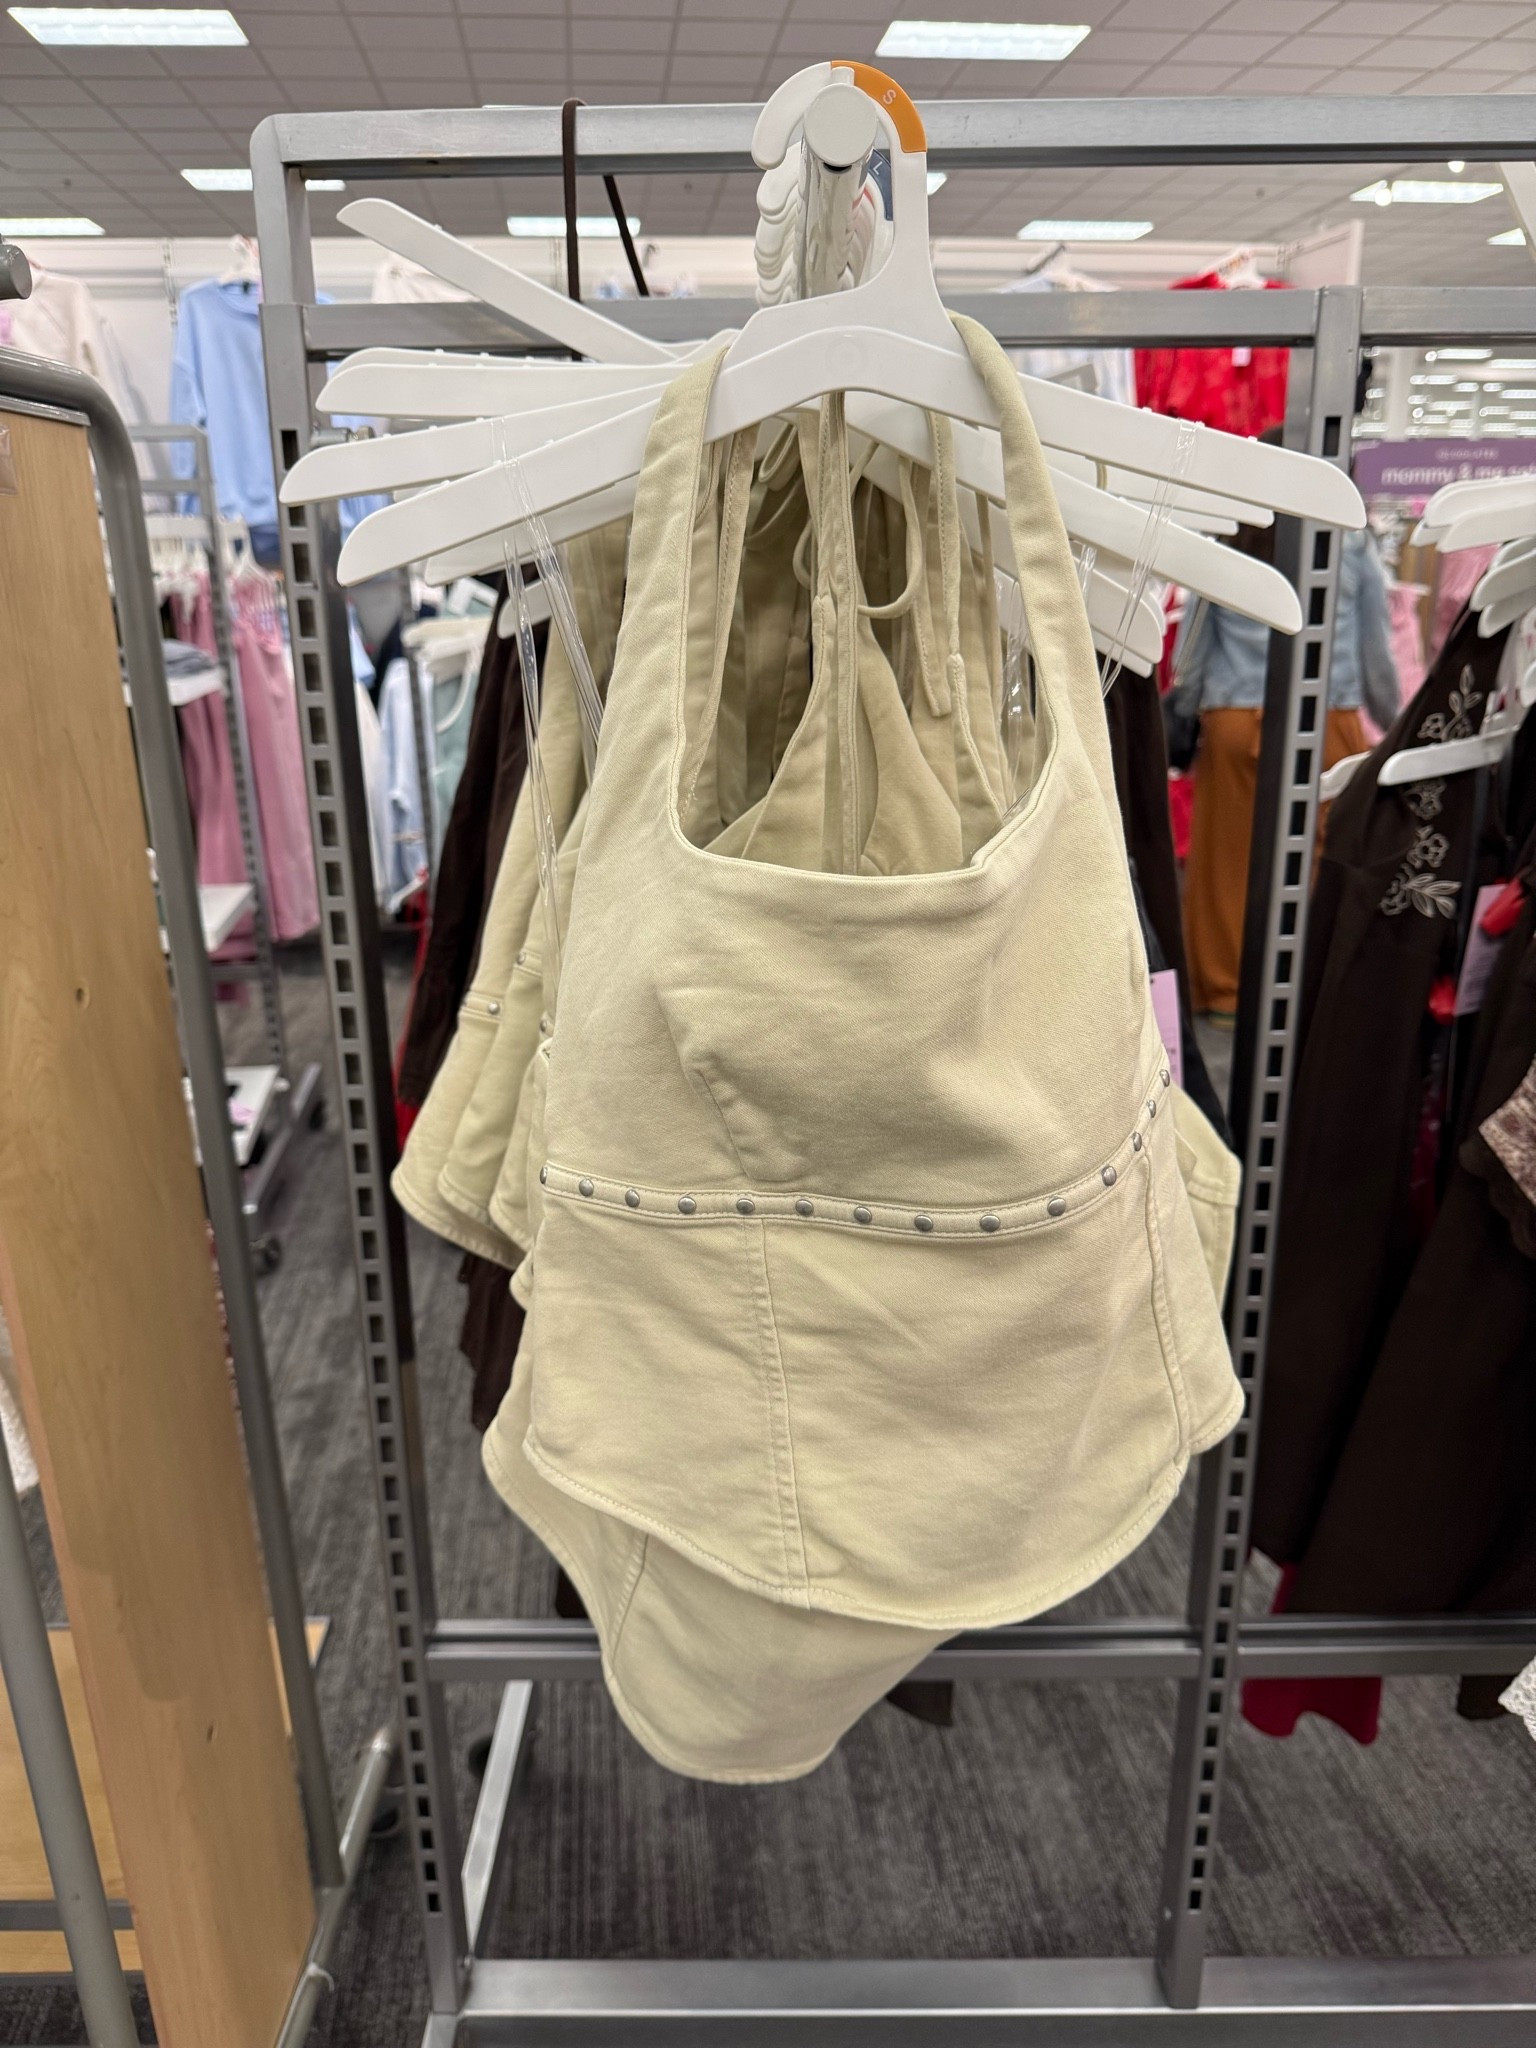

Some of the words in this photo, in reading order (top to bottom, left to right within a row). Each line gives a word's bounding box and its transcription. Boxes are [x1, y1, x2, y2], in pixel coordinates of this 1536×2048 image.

[883, 90, 896, 104] S
[873, 161, 883, 175] L
[1381, 466, 1455, 486] mommy
